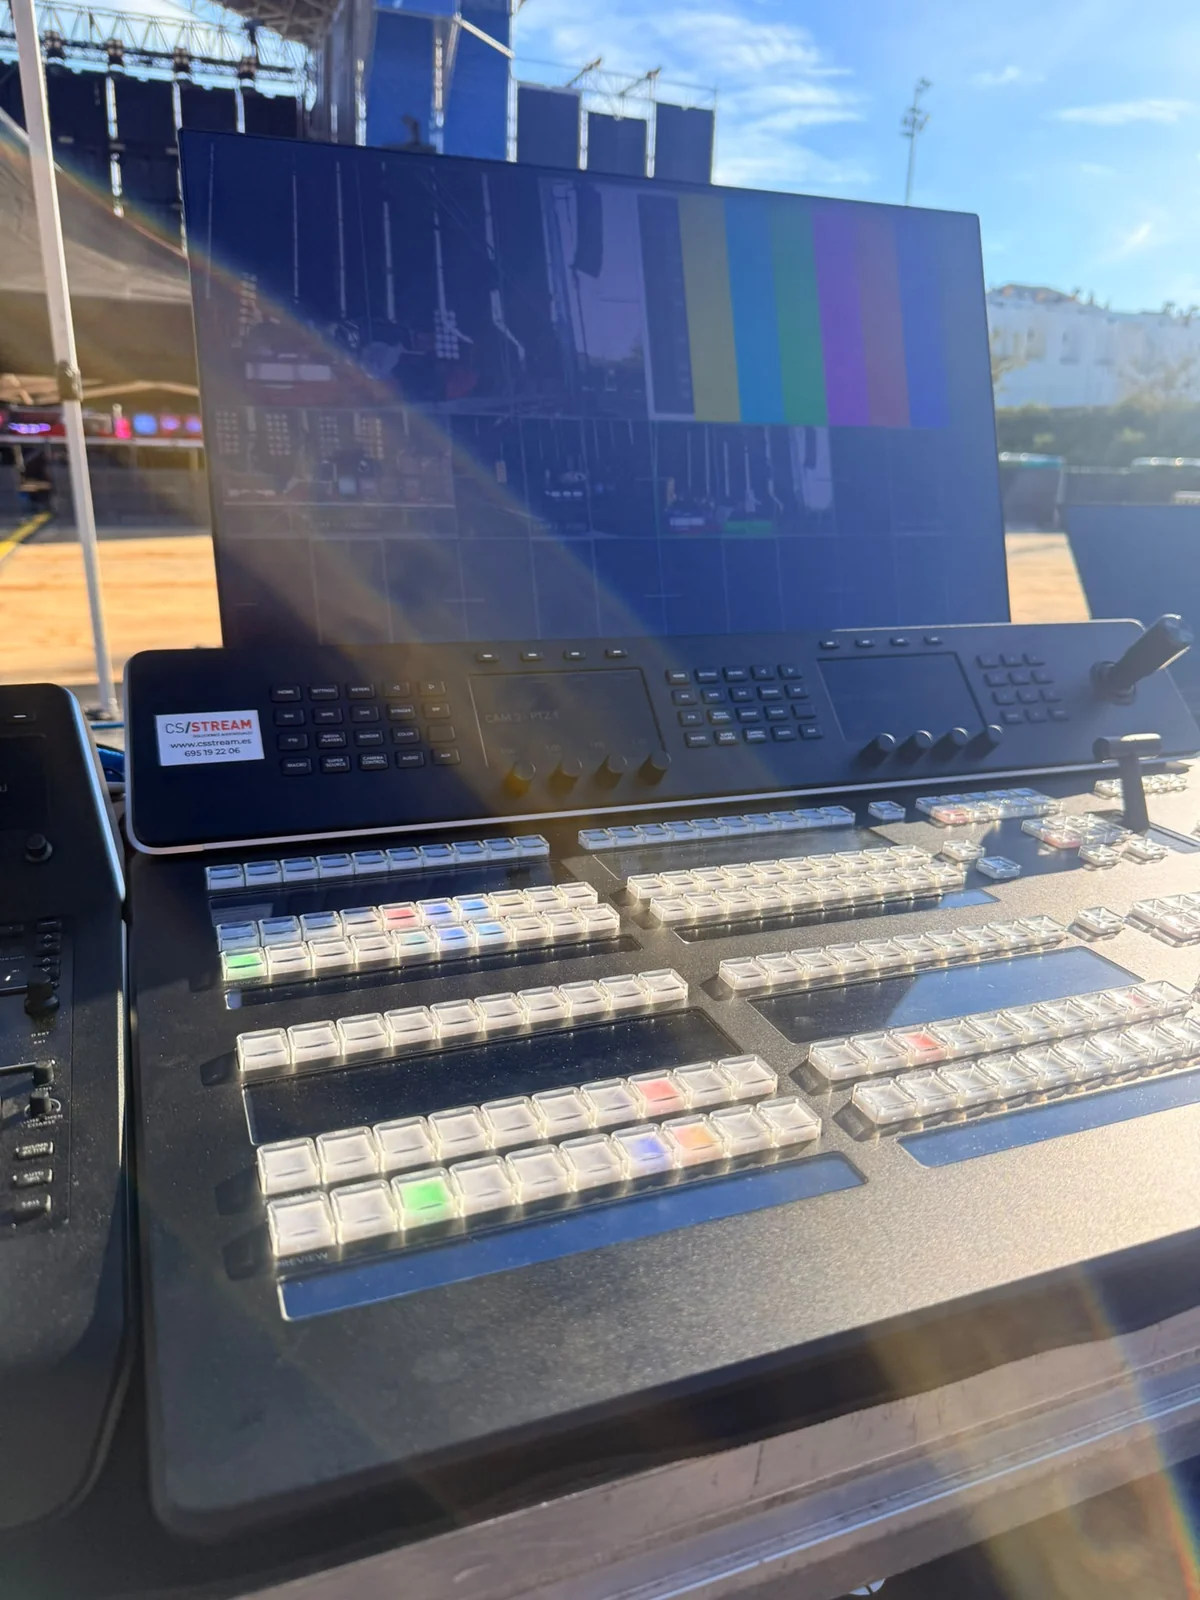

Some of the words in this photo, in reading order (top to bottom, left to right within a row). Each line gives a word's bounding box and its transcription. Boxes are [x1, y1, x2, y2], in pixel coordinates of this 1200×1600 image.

[170, 739, 252, 750] www.csstream.es
[184, 749, 202, 757] 695
[204, 748, 213, 756] 19
[215, 747, 227, 755] 22
[228, 746, 241, 754] 06
[27, 1119, 56, 1129] COARSE
